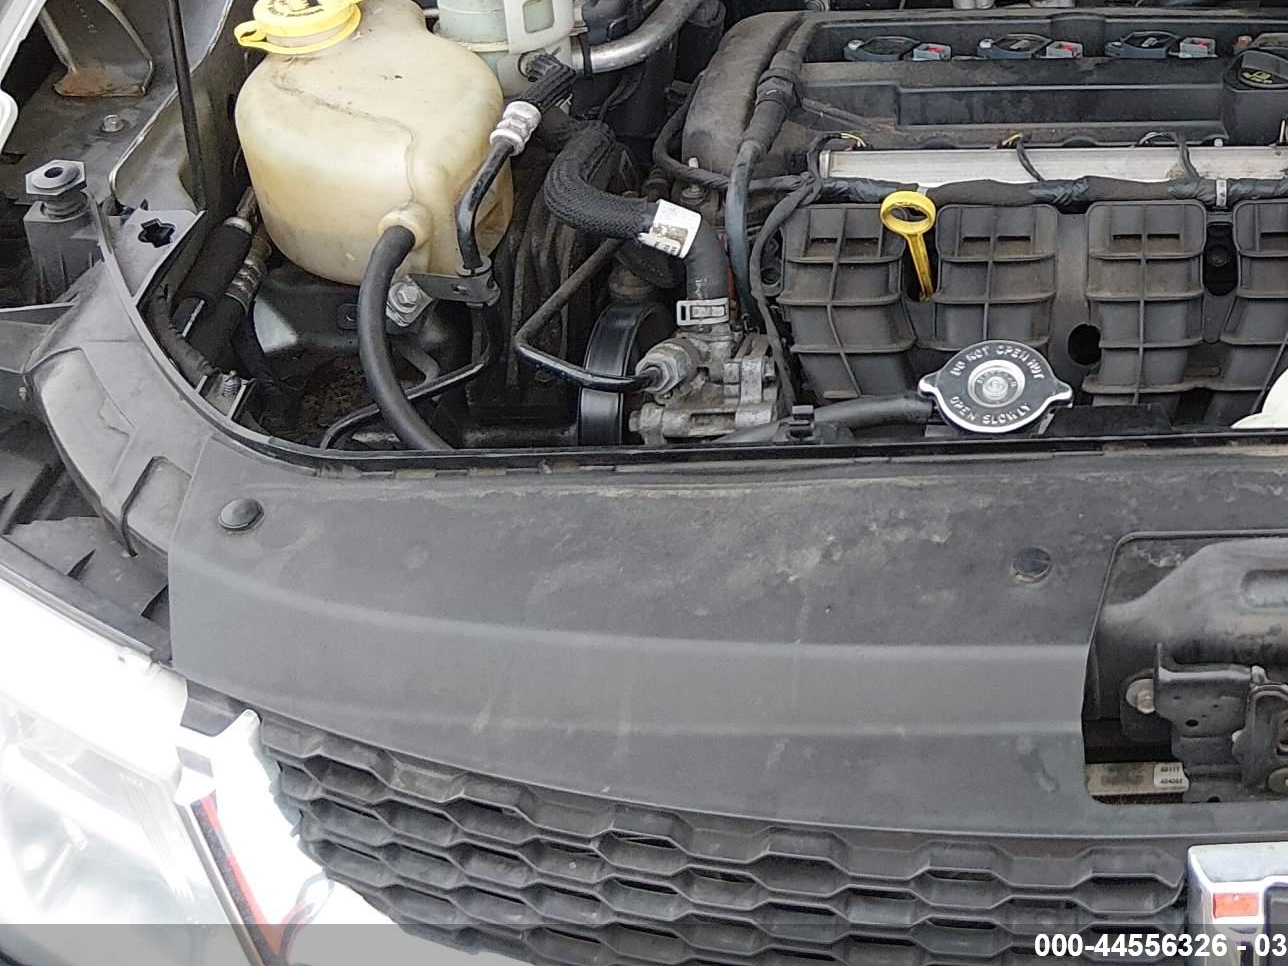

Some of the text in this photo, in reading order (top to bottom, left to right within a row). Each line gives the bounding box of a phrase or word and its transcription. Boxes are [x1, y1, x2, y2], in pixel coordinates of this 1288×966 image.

[950, 360, 966, 376] DO
[966, 346, 990, 362] NOT
[996, 345, 1030, 362] OPEN
[950, 395, 1031, 425] OPEN SLOWLY
